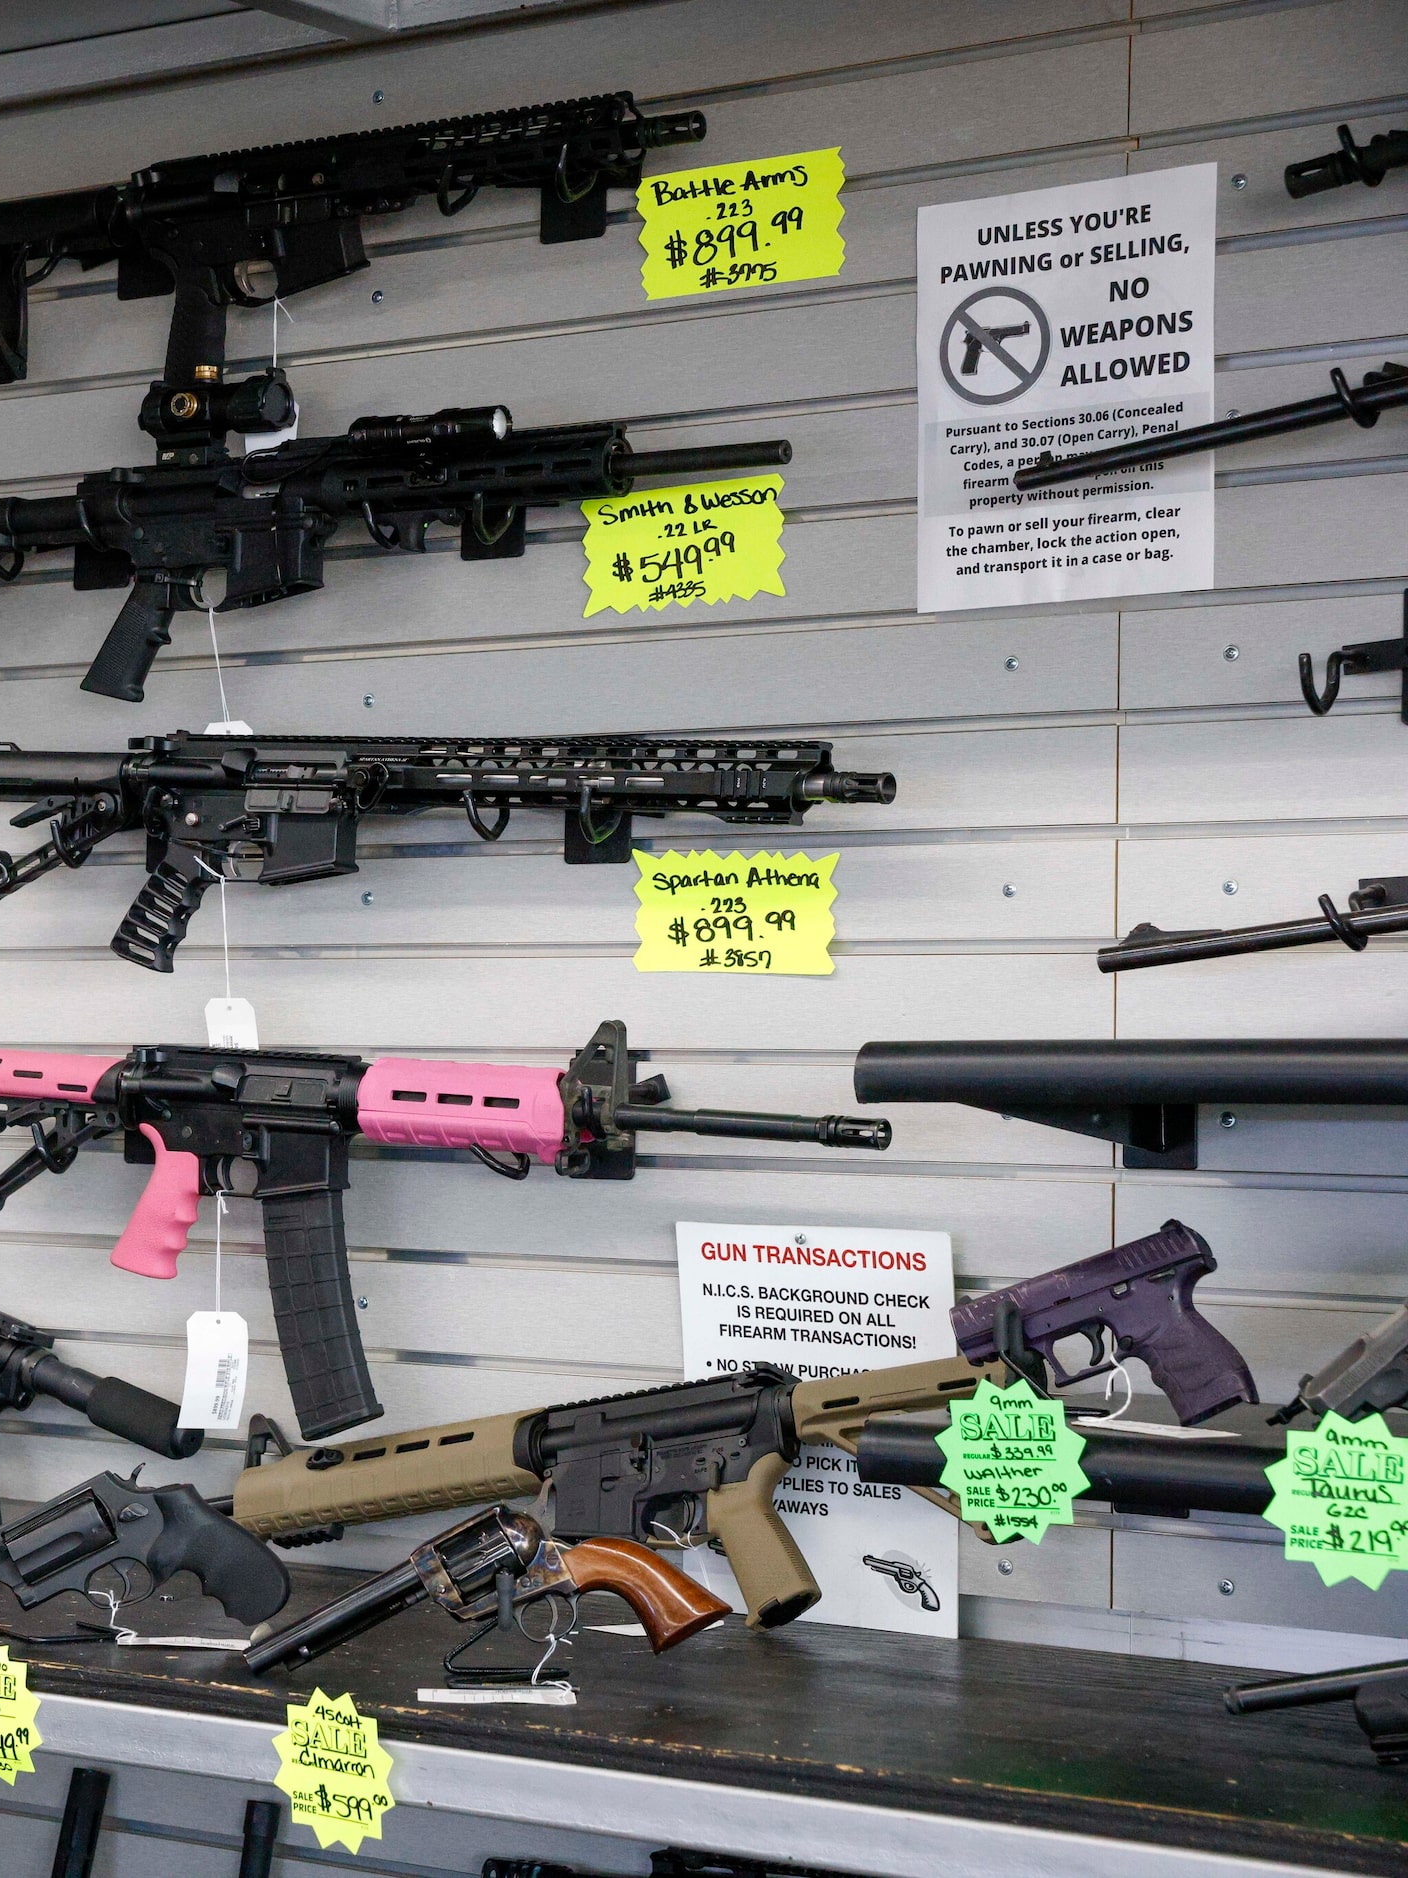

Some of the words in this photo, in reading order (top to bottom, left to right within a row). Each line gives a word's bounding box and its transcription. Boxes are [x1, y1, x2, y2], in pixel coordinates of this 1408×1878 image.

[977, 218, 1064, 246] UNLESS
[1070, 205, 1152, 233] YOU'RE
[940, 253, 1052, 284] PAWNING
[1060, 254, 1084, 269] or
[1090, 233, 1191, 264] SELLING,
[1109, 277, 1150, 302] NO
[1060, 310, 1193, 348] WEAPONS
[1060, 350, 1191, 386] ALLOWED
[946, 423, 1001, 437] Pursuant
[1005, 419, 1018, 432] to
[1022, 414, 1074, 430] Sections
[1078, 409, 1109, 425] 30.06
[1112, 402, 1183, 423] (Concealed
[950, 440, 991, 457] Carry),
[994, 436, 1018, 450] and
[1022, 434, 1055, 448] 30.07
[1058, 429, 1094, 446] (Open
[1097, 424, 1138, 441] Carry),
[1142, 421, 1179, 434] Penal
[963, 458, 1003, 473] Codes,
[1007, 458, 1014, 468] a
[963, 475, 1009, 490] firearm
[970, 491, 1023, 509] property
[1027, 487, 1079, 503] without
[1082, 479, 1154, 498] permission.
[949, 526, 964, 537] To
[968, 525, 1004, 539] pawn
[1008, 522, 1021, 533] or
[1025, 518, 1049, 532] sell
[1052, 516, 1084, 533] your
[1087, 509, 1142, 527] firearm,
[1146, 506, 1181, 519] clear
[946, 545, 967, 557] the
[971, 539, 1034, 556] chamber,
[1037, 535, 1067, 549] lock
[1071, 534, 1092, 547] the
[1096, 529, 1138, 544] action
[1142, 527, 1181, 542] open,
[956, 563, 980, 576] and
[984, 559, 1047, 576] transport
[1051, 556, 1062, 568] it
[1065, 555, 1078, 566] in
[1082, 556, 1089, 565] a
[1092, 552, 1122, 563] case
[1126, 550, 1141, 561] or
[1144, 546, 1174, 562] bag.
[702, 1242, 747, 1262] GUN
[752, 1245, 927, 1272] TRANSACTIONS
[703, 1283, 754, 1300] N.I.C.S.
[758, 1286, 869, 1305] BACKGROUND
[874, 1294, 929, 1309] CHECK
[737, 1305, 750, 1318] IS
[755, 1307, 833, 1323] REQUIRED
[838, 1311, 861, 1325] ON
[867, 1313, 896, 1328] ALL
[719, 1324, 786, 1341] FIREARM
[790, 1328, 916, 1349] TRANSACTIONS!
[959, 1413, 1056, 1441] SALE
[1294, 1446, 1403, 1484] SALE
[967, 1487, 991, 1495] SALE
[967, 1499, 995, 1507] PRICE
[291, 1719, 367, 1758] SALE
[293, 1791, 313, 1801] SALE
[293, 1802, 317, 1814] PRICE
